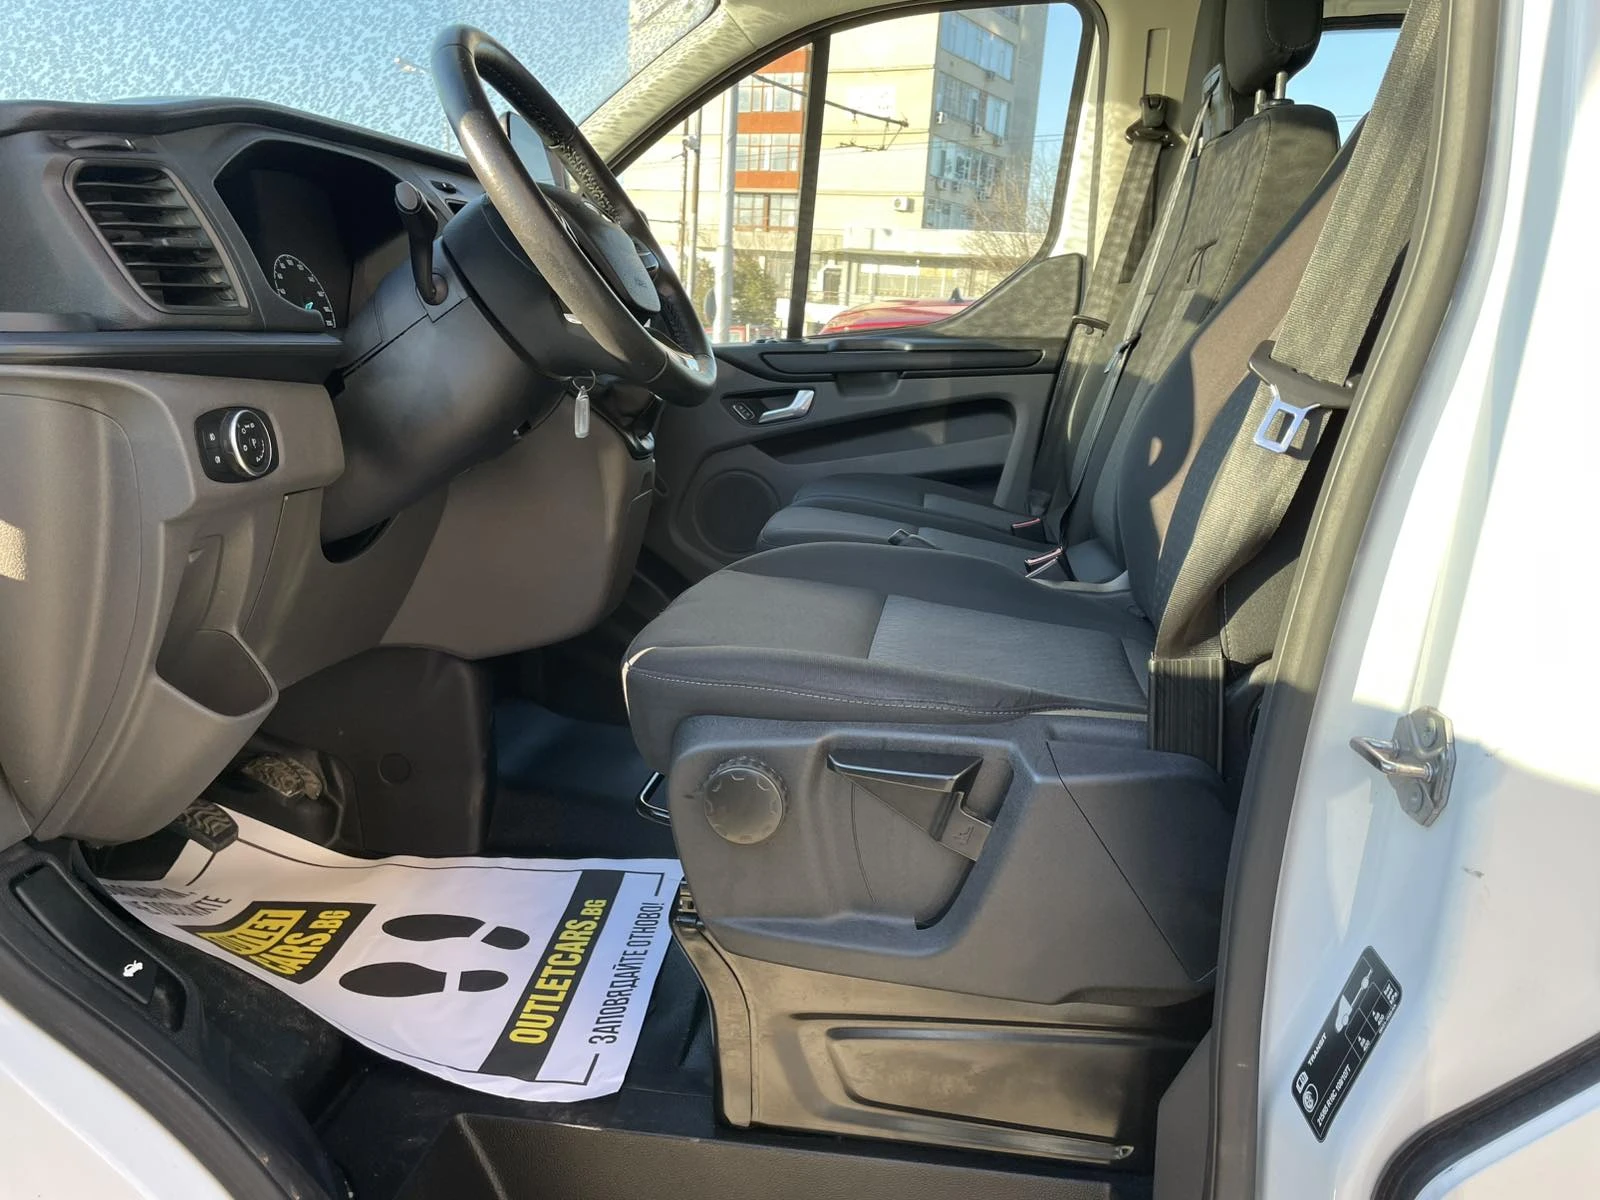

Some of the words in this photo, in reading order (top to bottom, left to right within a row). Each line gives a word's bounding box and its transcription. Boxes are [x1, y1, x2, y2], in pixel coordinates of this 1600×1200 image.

[508, 899, 608, 1045] OUTLETCARS.BG
[588, 949, 649, 1045] ЗАПОВЯДАЙТЕ
[626, 902, 665, 947] ОТНОВО!
[1307, 1032, 1328, 1067] TRANSIT
